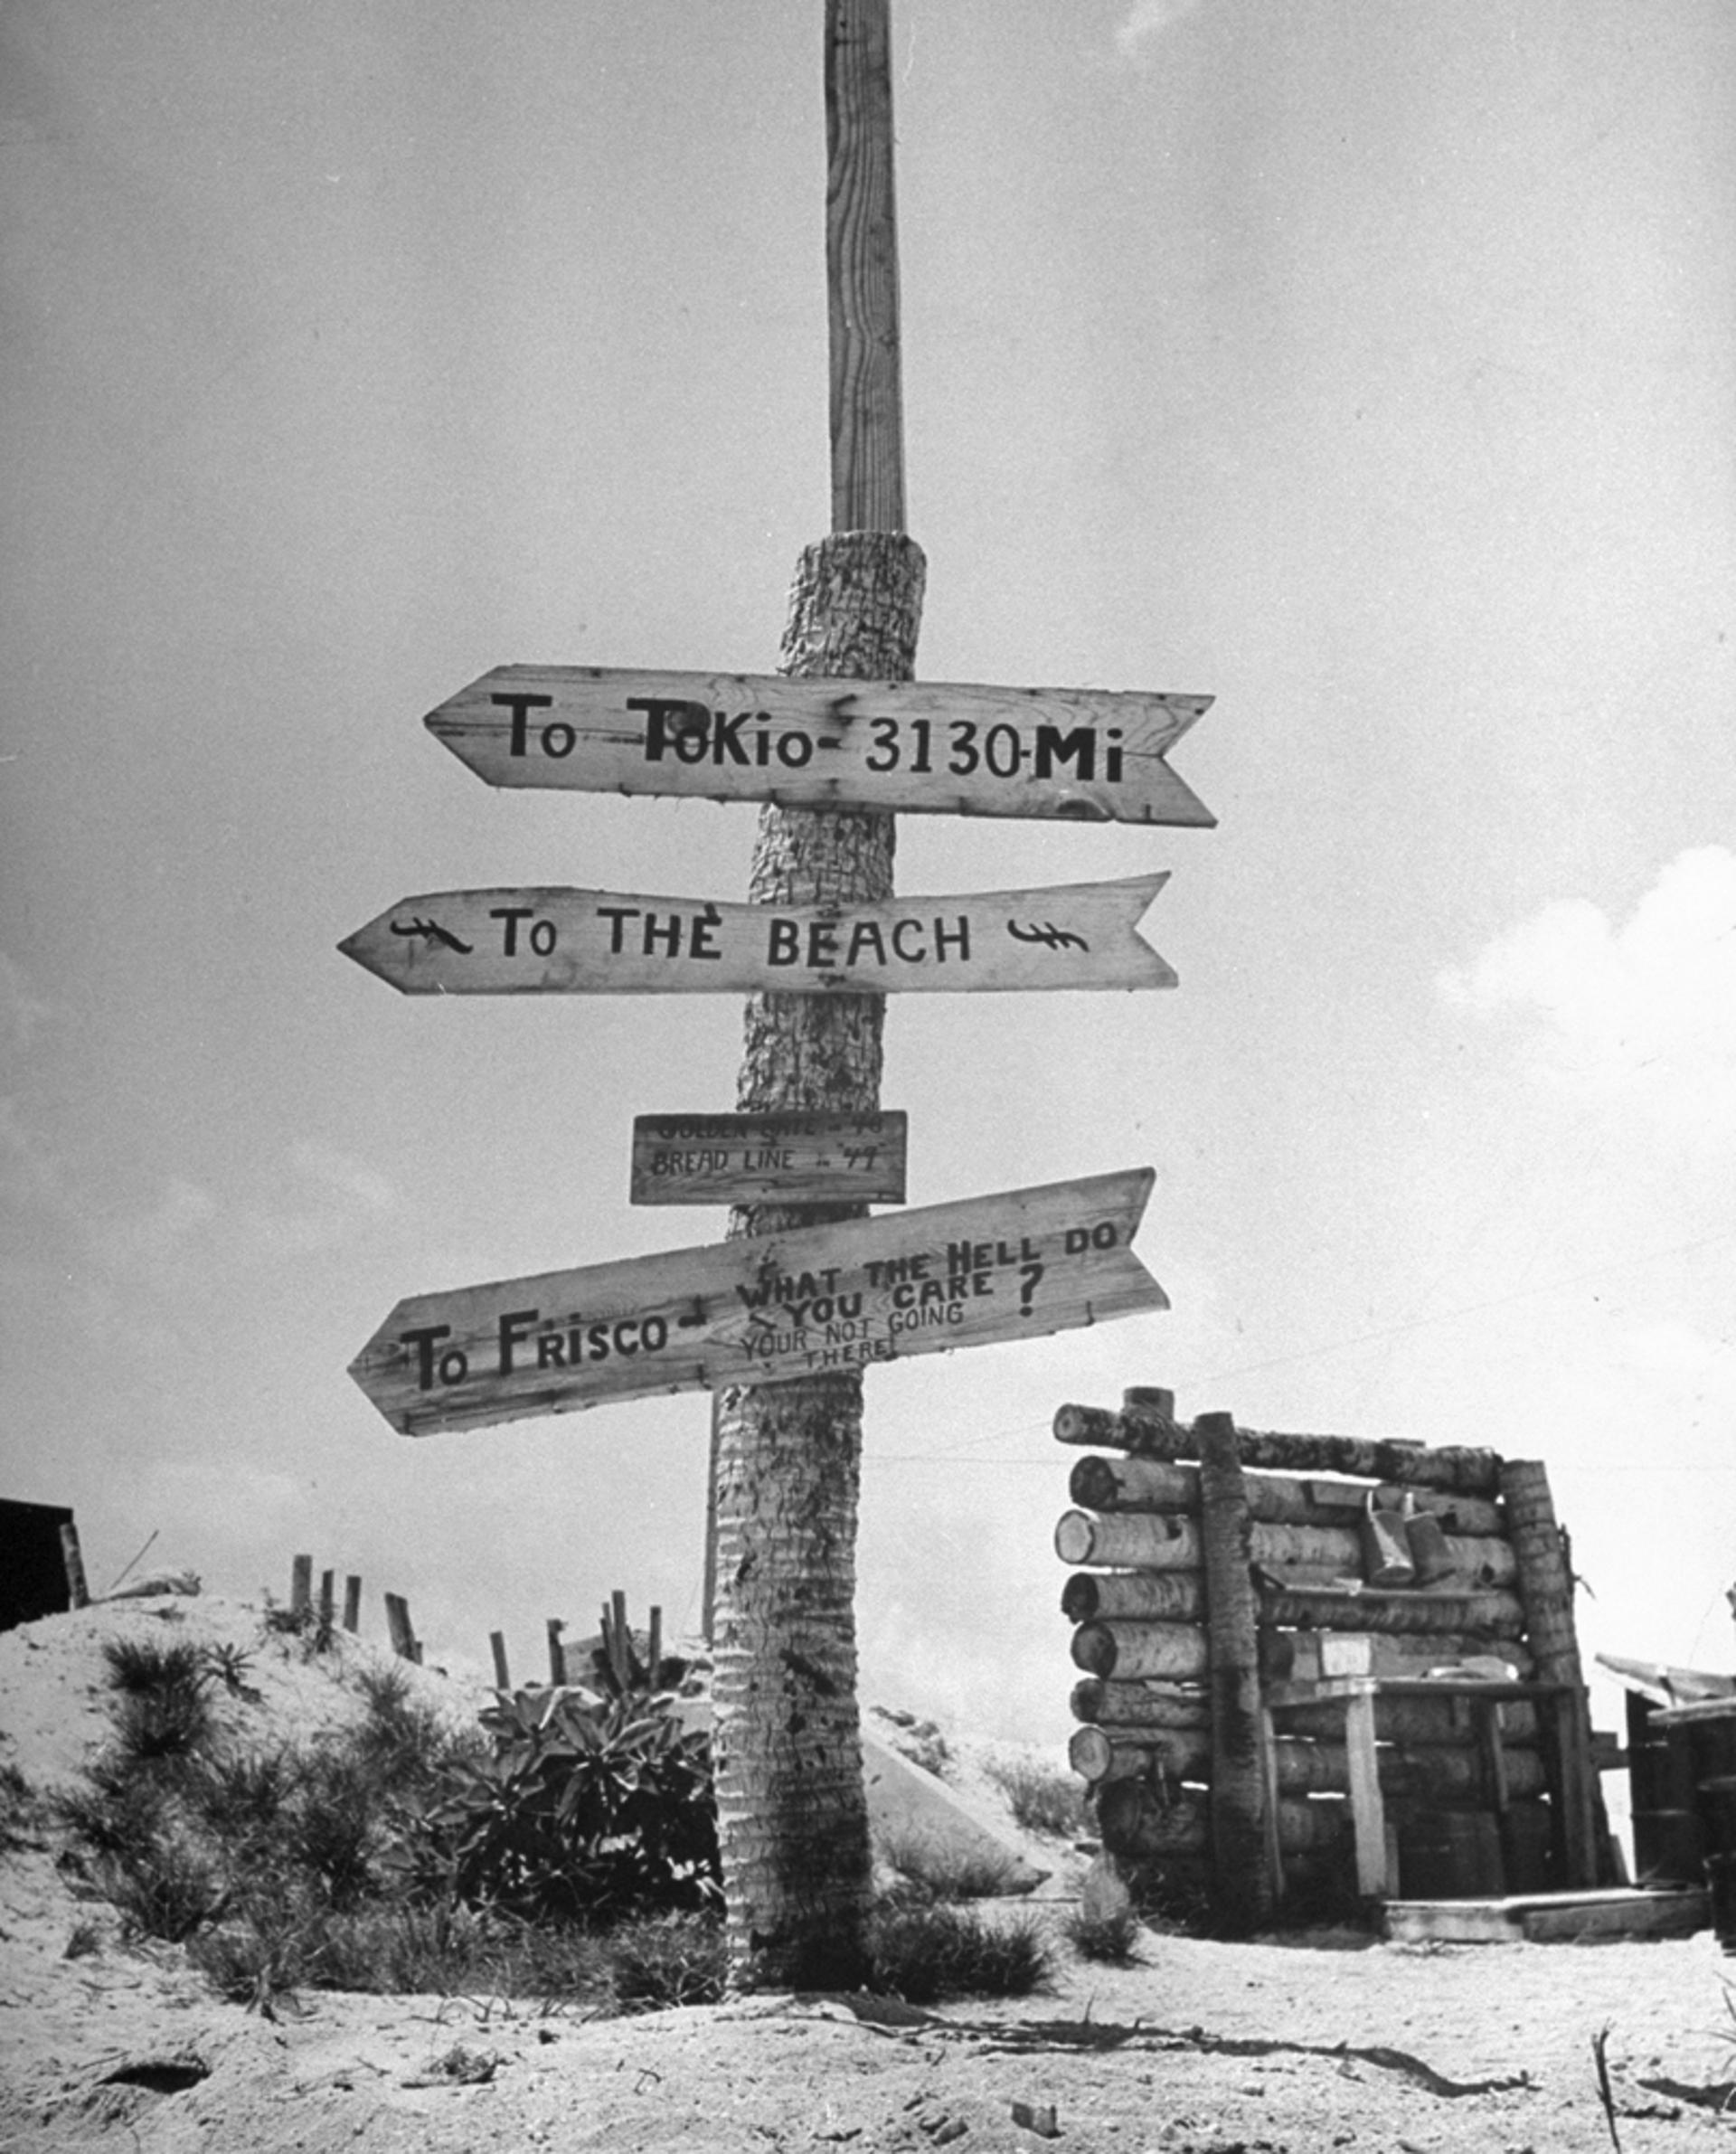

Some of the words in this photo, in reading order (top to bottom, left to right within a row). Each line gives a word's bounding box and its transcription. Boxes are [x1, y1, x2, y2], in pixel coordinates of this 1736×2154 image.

[491, 693, 576, 758] To
[489, 908, 557, 957] To
[597, 902, 722, 959] THE
[768, 914, 970, 968] BEACH
[651, 1150, 728, 1176] BREAD
[743, 1149, 796, 1172] LINE
[736, 1268, 842, 1308] WHAT
[863, 1253, 930, 1288] THE
[947, 1238, 1041, 1273] HELL
[1065, 1222, 1118, 1255] DO
[782, 1292, 862, 1327] YOU
[892, 1271, 994, 1308] CARE
[400, 1325, 468, 1391] To
[741, 1329, 807, 1361] YOUR
[826, 1318, 874, 1345] NOT
[888, 1302, 964, 1335] GOING
[806, 1339, 888, 1368] THERE
